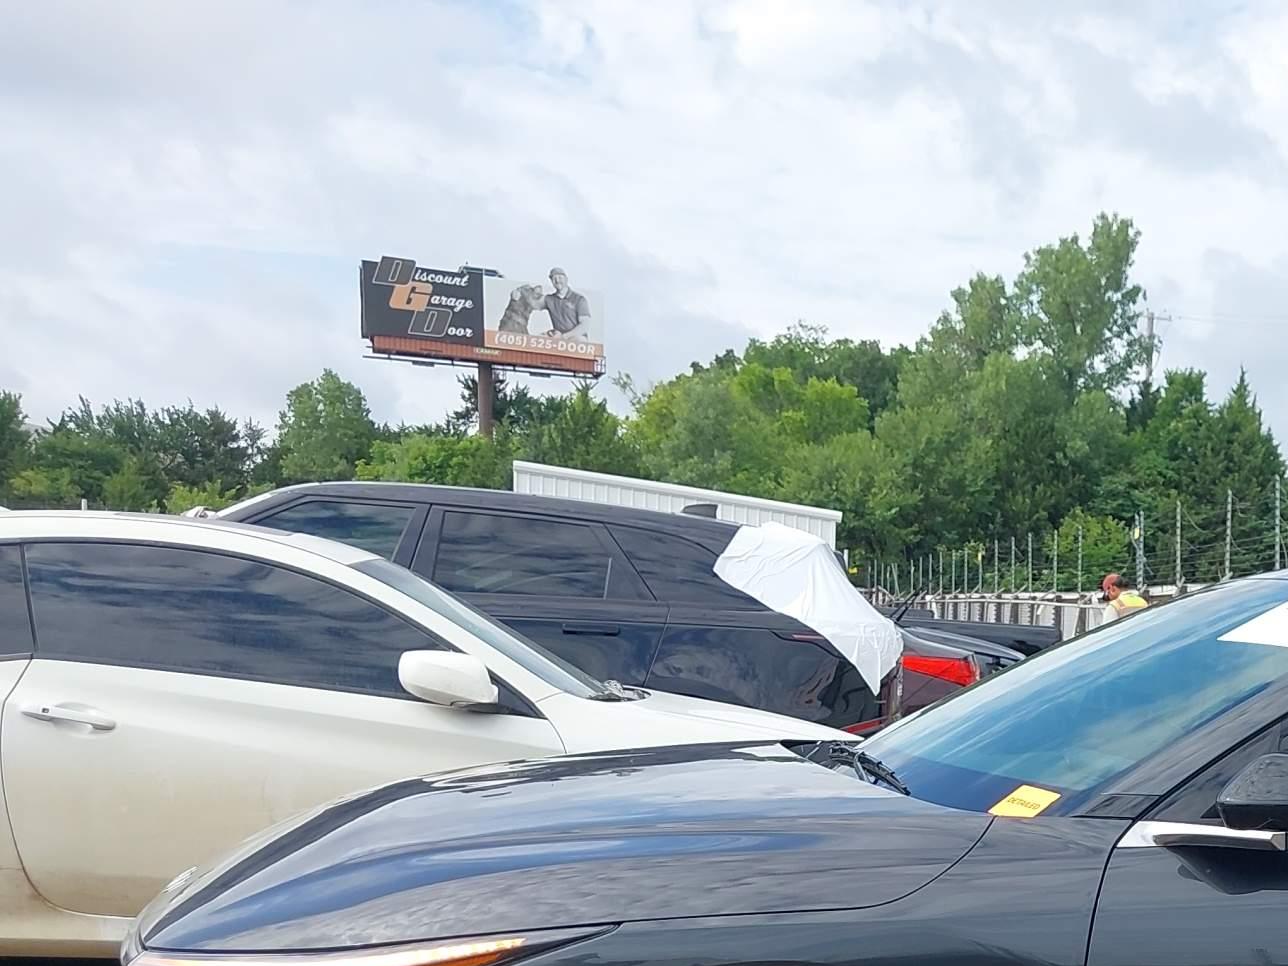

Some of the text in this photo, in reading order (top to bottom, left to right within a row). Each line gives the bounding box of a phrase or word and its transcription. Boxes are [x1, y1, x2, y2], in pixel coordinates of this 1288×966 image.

[373, 256, 470, 288] Discount
[389, 281, 474, 314] Garage
[408, 307, 473, 337] Door
[494, 333, 596, 356] (405) 525-DOOR
